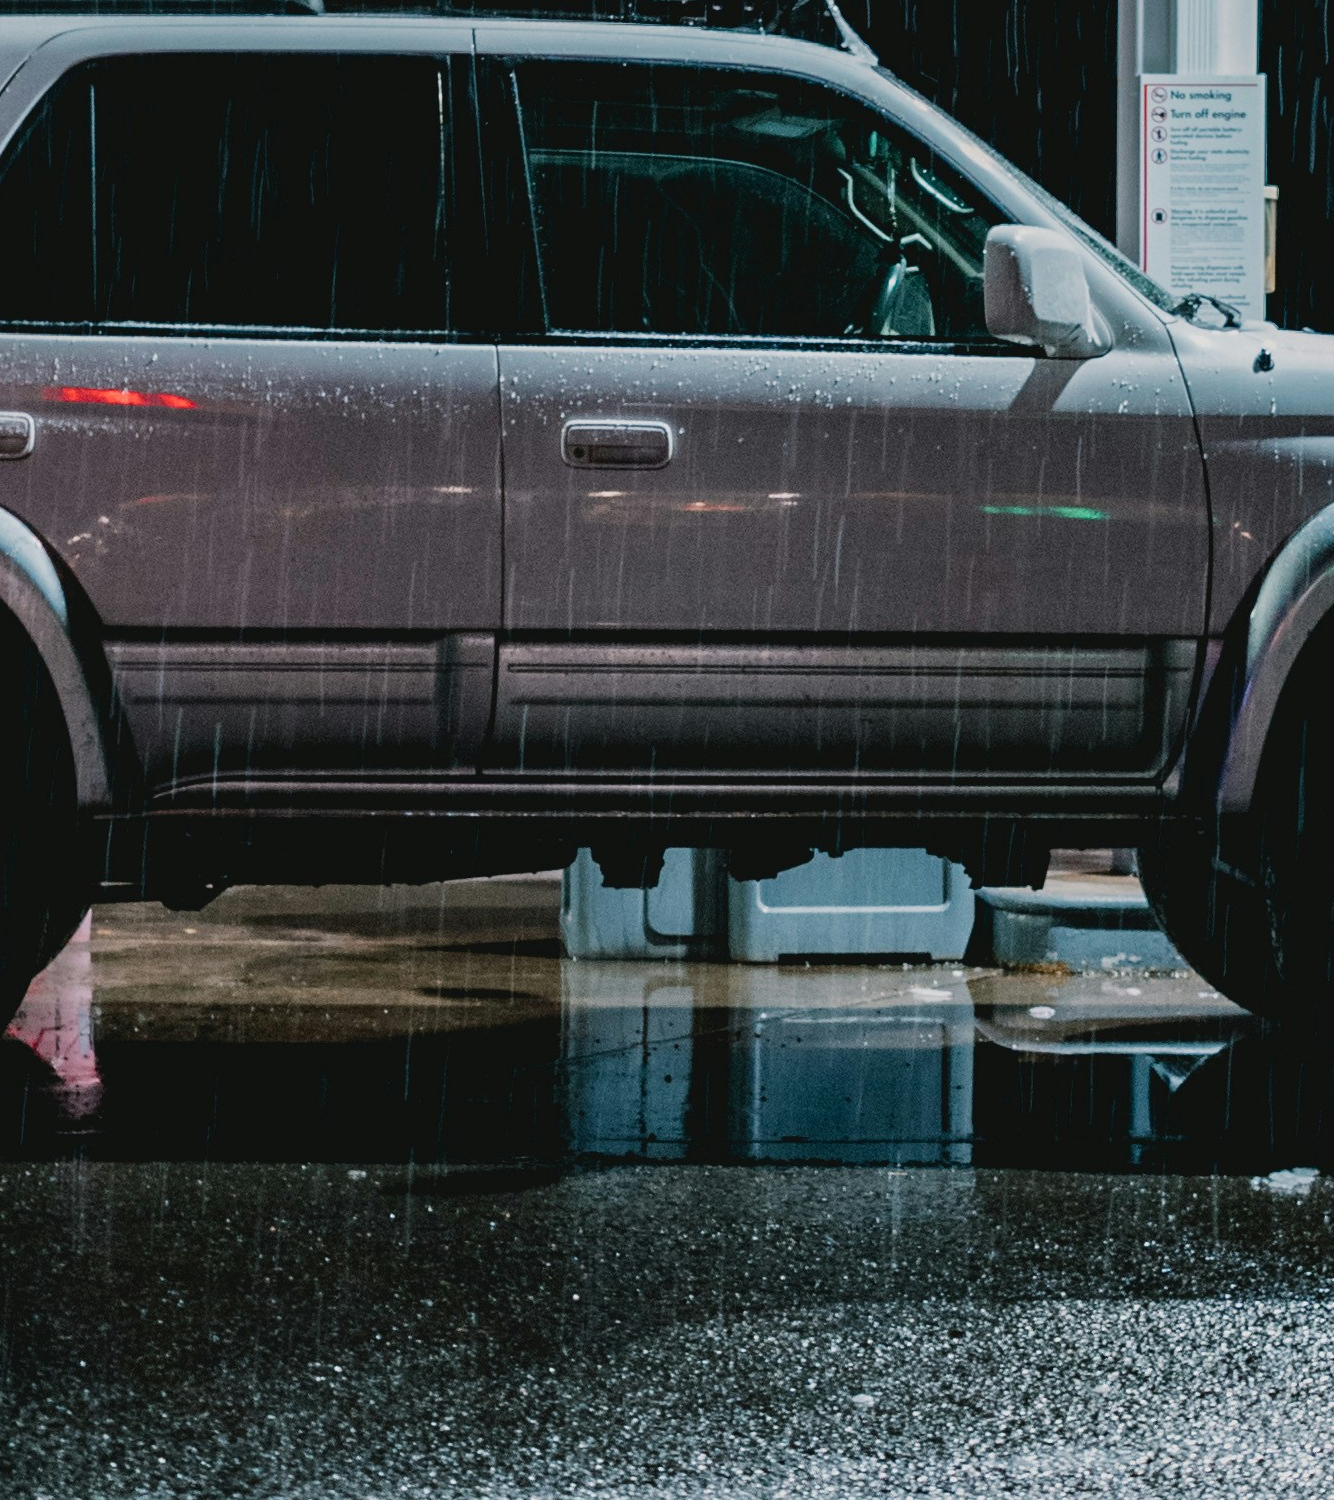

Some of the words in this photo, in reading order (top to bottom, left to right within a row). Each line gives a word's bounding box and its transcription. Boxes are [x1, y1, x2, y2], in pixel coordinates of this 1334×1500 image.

[1170, 90, 1186, 99] No
[1189, 89, 1232, 102] smoking
[1170, 109, 1192, 118] Turn
[1194, 108, 1209, 118] off
[1212, 108, 1246, 121] engine
